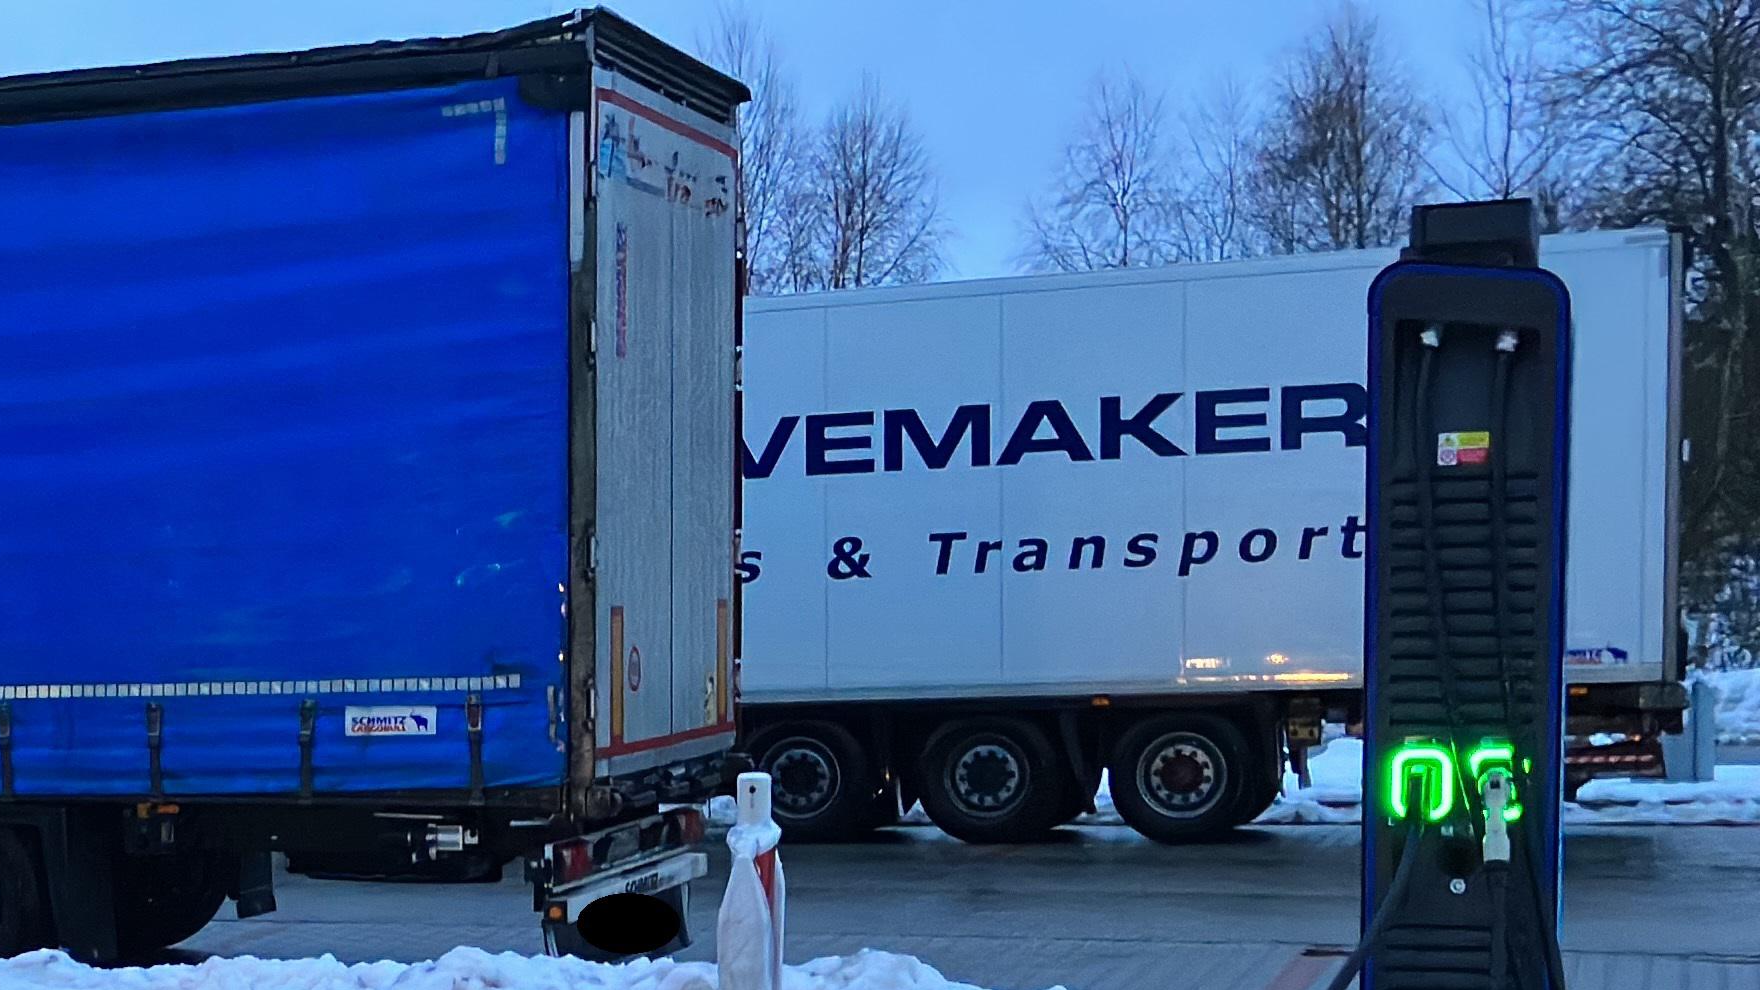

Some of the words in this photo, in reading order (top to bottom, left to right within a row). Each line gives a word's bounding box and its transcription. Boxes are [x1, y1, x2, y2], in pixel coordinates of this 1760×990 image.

[742, 382, 1367, 479] VEMAKER
[827, 536, 872, 580] &
[929, 516, 1367, 577] Transport
[351, 716, 407, 726] SCHMITZ
